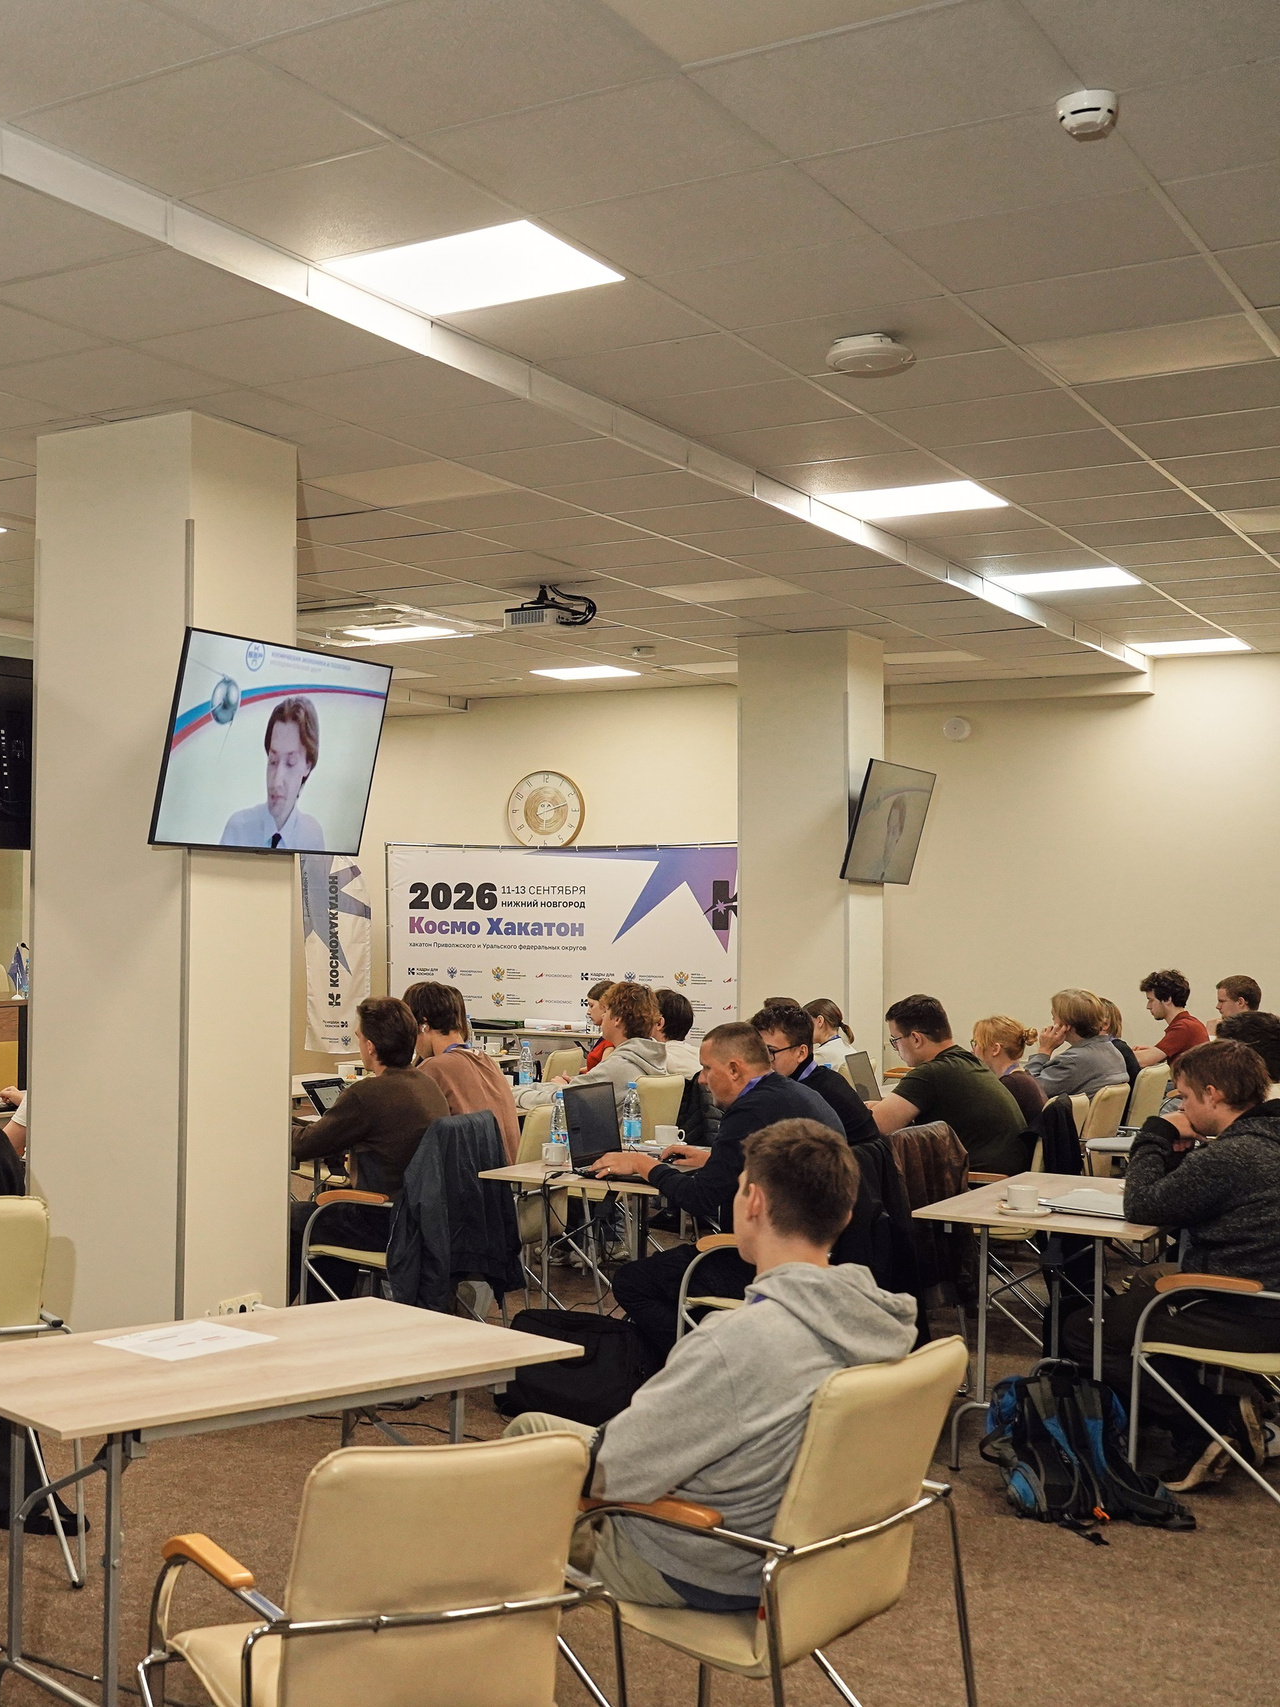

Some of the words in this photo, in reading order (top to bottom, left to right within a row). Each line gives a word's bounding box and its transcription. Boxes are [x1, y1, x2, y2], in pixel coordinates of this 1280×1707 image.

[408, 882, 498, 911] 2026
[501, 886, 526, 895] 11-13
[528, 886, 586, 895] СЕНТЯБРЯ
[501, 899, 539, 908] НИЖНИЙ
[540, 901, 586, 909] НОВГОРОД
[409, 916, 481, 935] Космо
[486, 917, 585, 937] Хакатон
